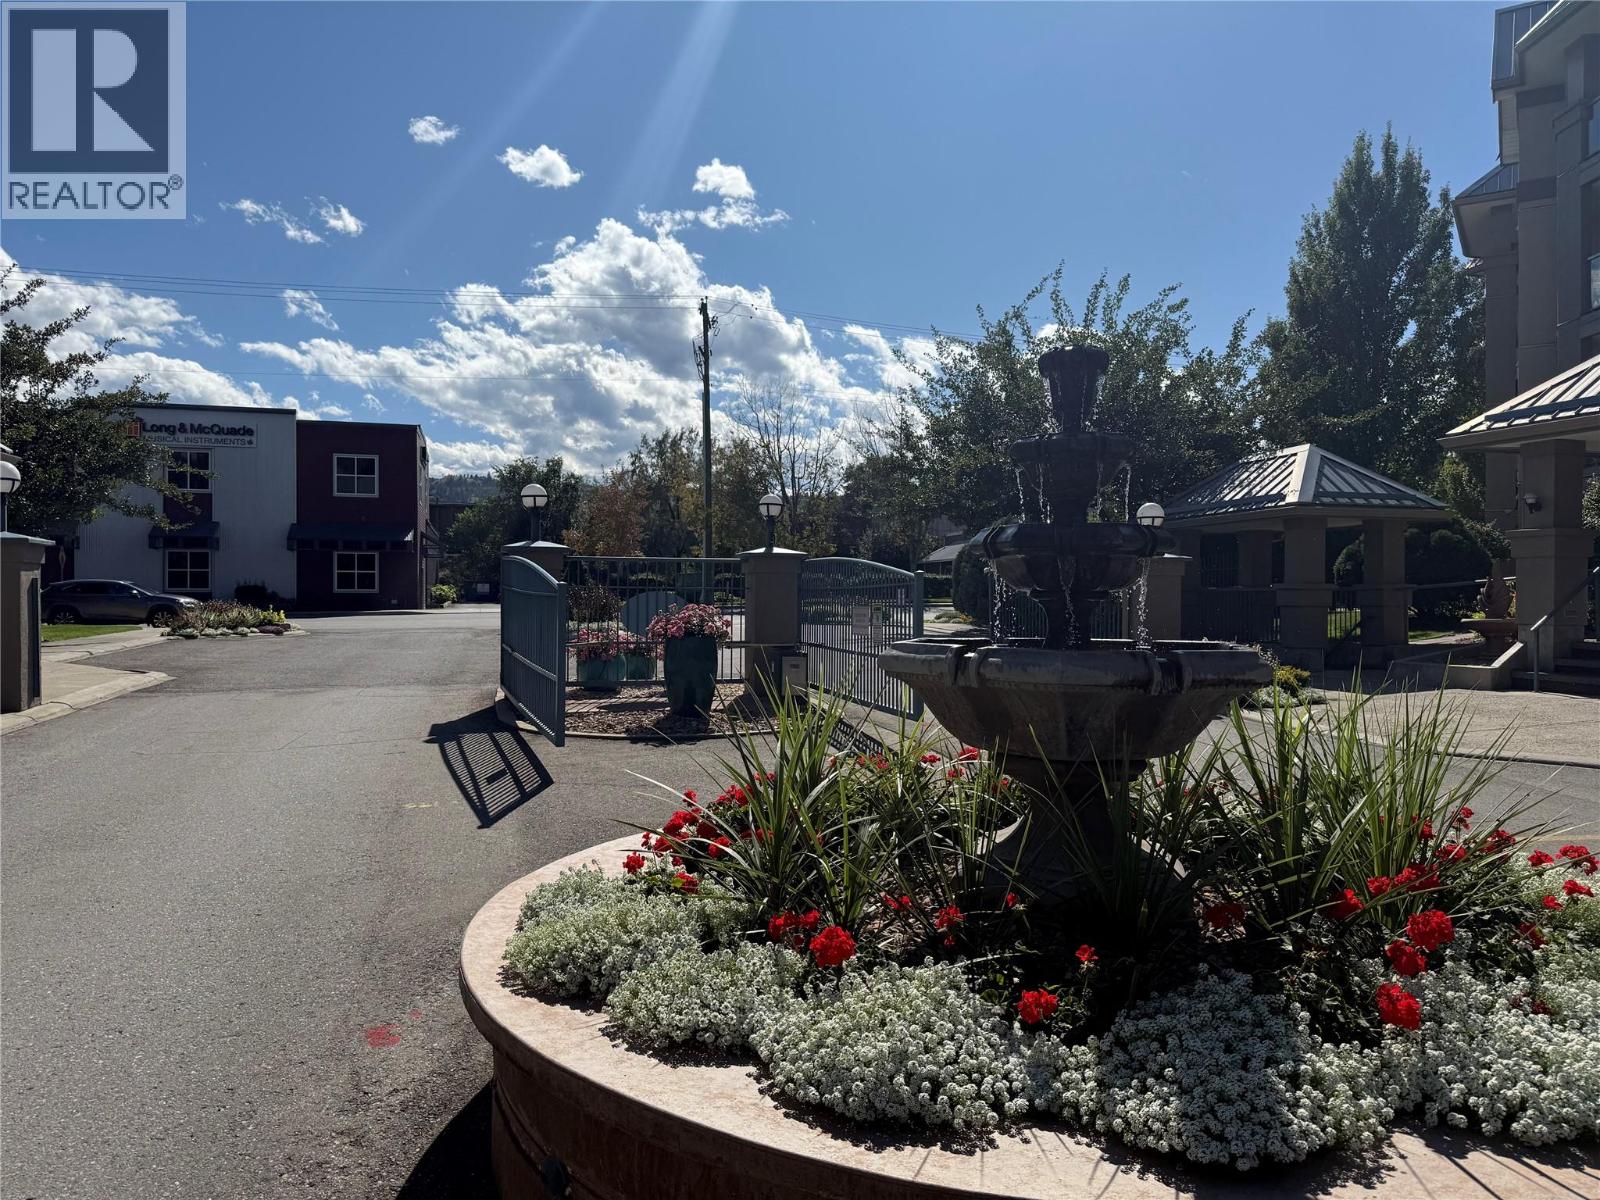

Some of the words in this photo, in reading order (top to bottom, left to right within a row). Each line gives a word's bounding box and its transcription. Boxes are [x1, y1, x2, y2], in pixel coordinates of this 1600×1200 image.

[142, 422, 176, 435] Long
[178, 422, 189, 434] &
[190, 423, 254, 436] McQuade
[184, 437, 246, 446] INSTRUMENTS
